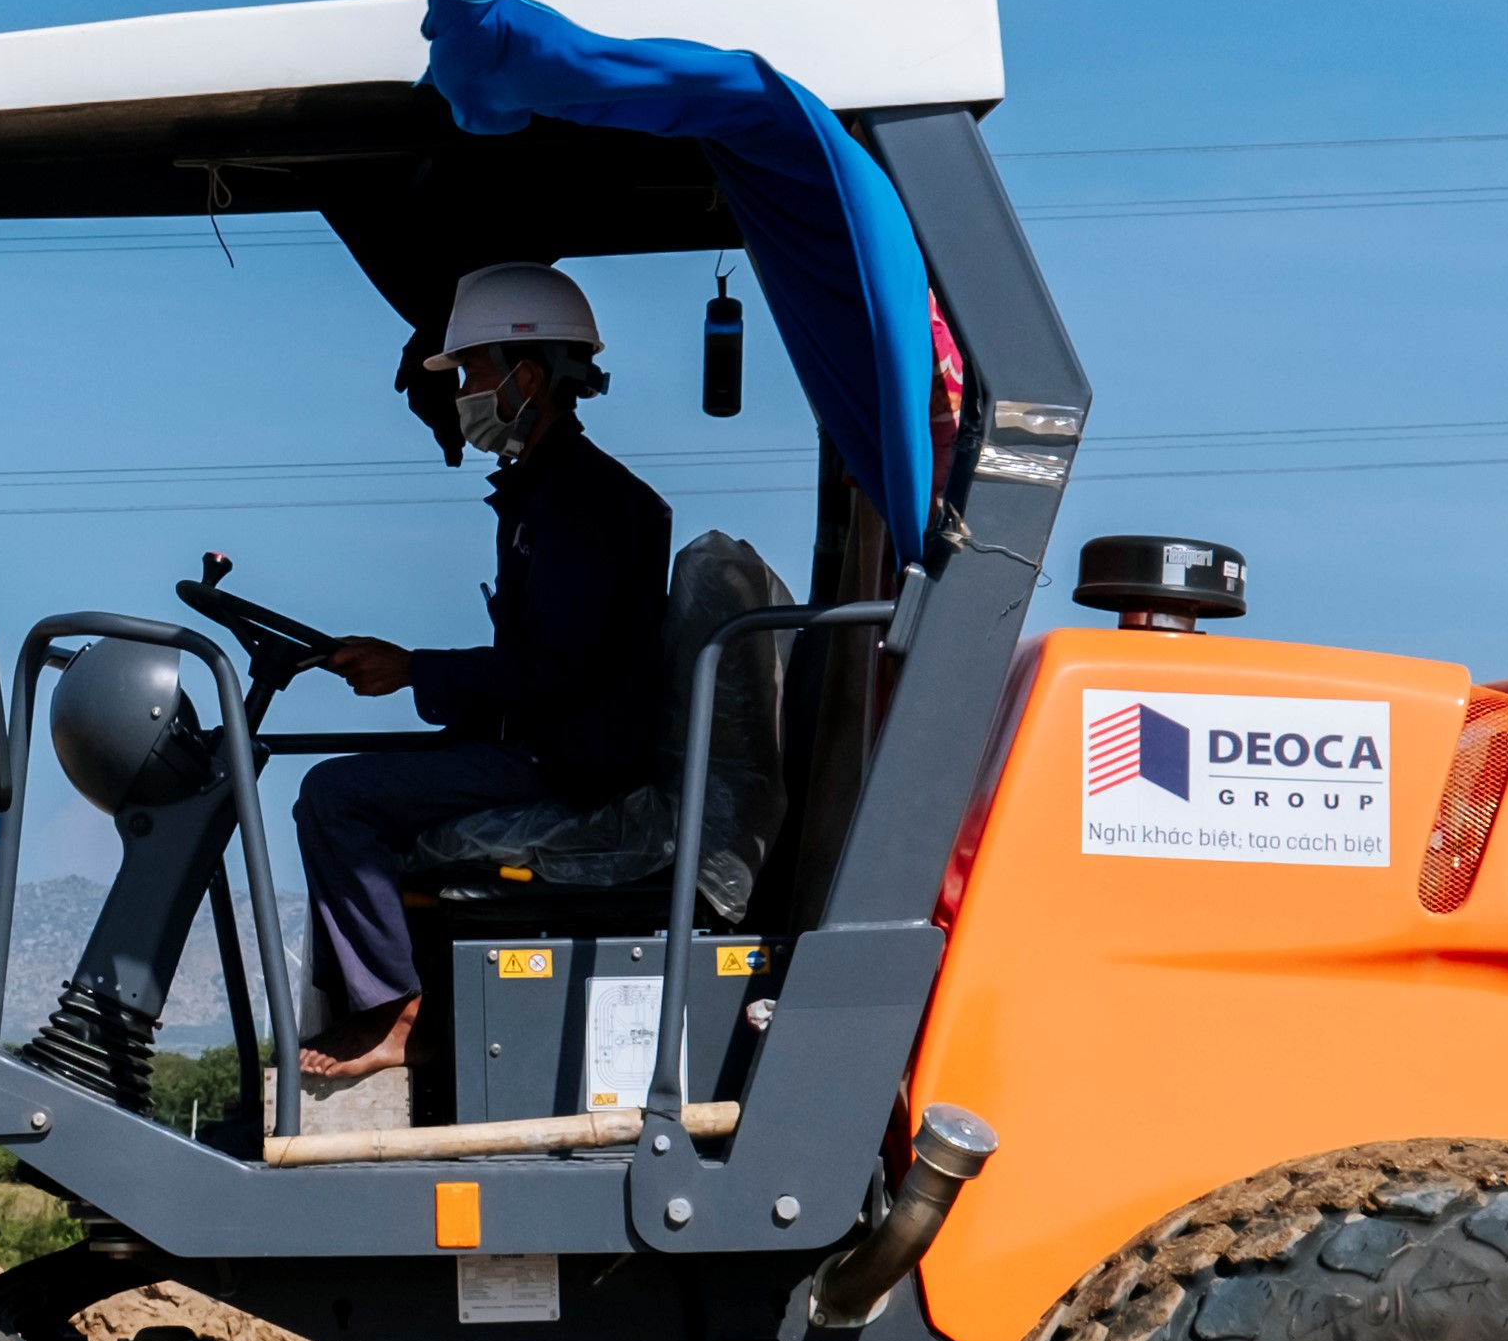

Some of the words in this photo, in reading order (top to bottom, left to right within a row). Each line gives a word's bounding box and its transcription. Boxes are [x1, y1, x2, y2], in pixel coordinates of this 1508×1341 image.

[1208, 729, 1383, 770] DEOCA
[1218, 789, 1374, 810] GROUP
[1088, 822, 1137, 843] Nghĩ
[1141, 825, 1194, 846] khác
[1248, 832, 1281, 852] tạo
[1286, 833, 1338, 852] cách
[1343, 834, 1383, 856] biệt
